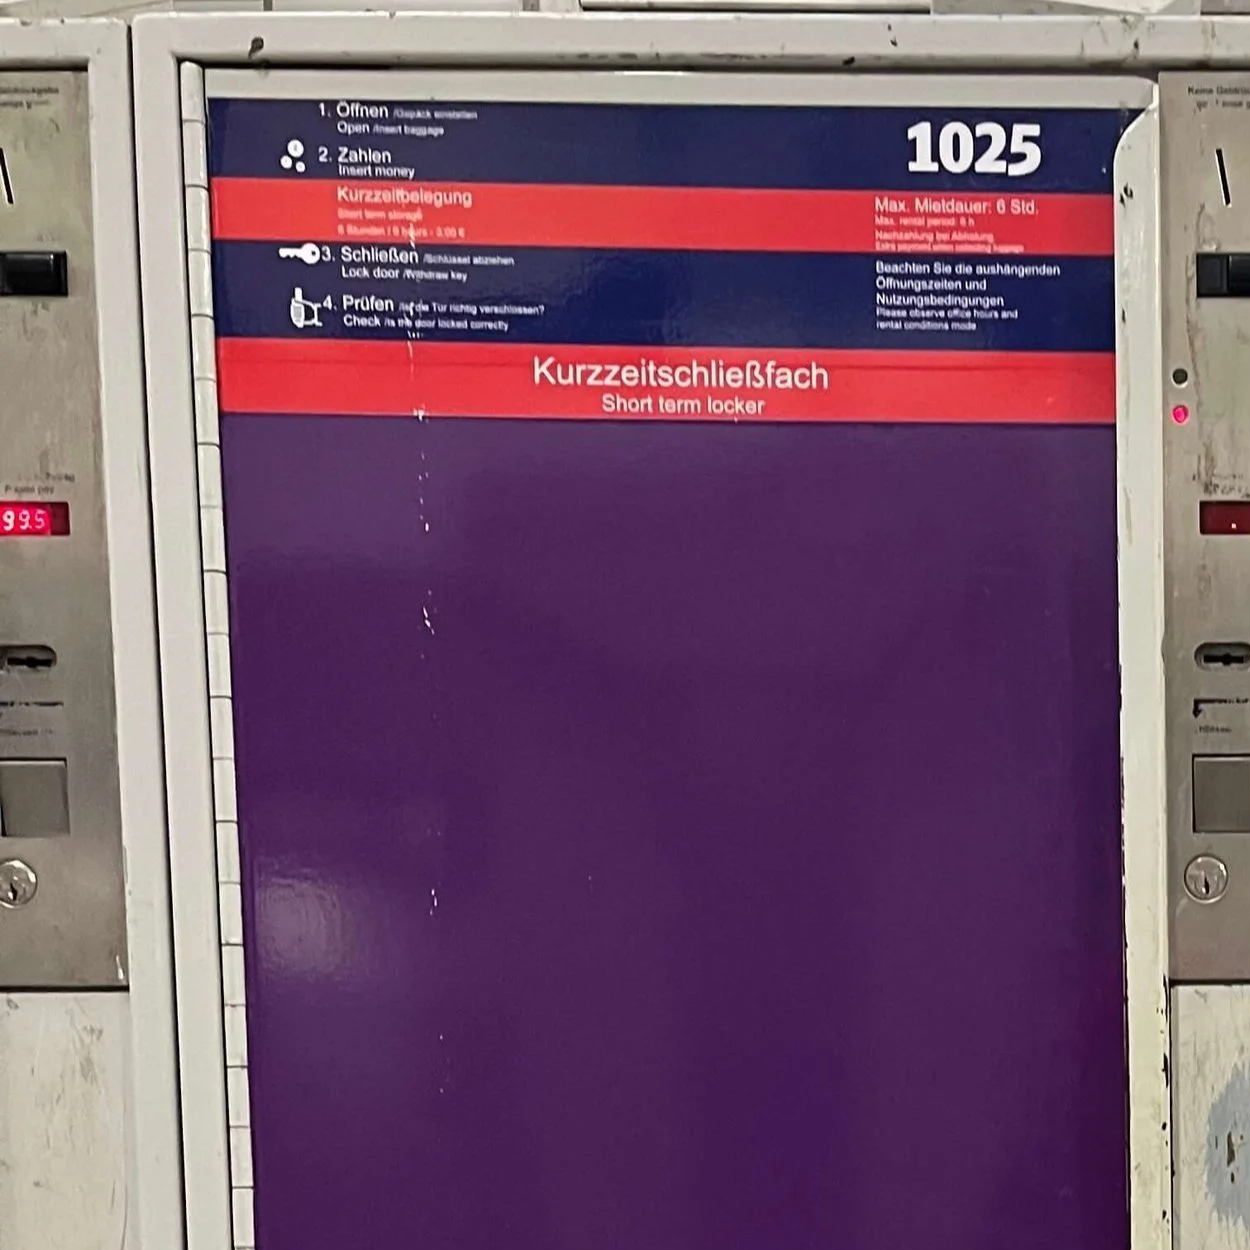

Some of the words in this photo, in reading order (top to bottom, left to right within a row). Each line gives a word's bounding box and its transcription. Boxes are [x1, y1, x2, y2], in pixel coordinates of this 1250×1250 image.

[318, 102, 331, 118] 1.
[336, 100, 389, 119] Öffnen
[337, 121, 370, 136] Open
[318, 147, 332, 163] 2.
[337, 147, 392, 164] Zahlen
[907, 121, 1042, 177] 1025
[339, 165, 373, 177] Insert
[375, 165, 415, 180] money
[337, 186, 473, 208] Kurzzeitbelegung
[874, 197, 910, 213] Max.
[915, 198, 992, 214] Mietdauer:
[996, 198, 1007, 214] 6
[1010, 198, 1039, 215] Std.
[321, 247, 335, 262] 3.
[341, 246, 419, 264] Schließen
[341, 267, 370, 278] Lock
[373, 266, 400, 279] door
[876, 261, 930, 275] Beachten
[933, 262, 952, 275] Sie
[955, 262, 973, 275] die
[975, 263, 1061, 278] aushängenden
[876, 276, 962, 292] Öffnungszeiten
[965, 278, 987, 291] und
[322, 296, 337, 311] 4.
[343, 294, 394, 312] Prüfen
[876, 292, 1004, 309] Nutzungsbedingungen
[343, 315, 380, 328] Check
[533, 355, 829, 390] Kurzzeitschließfach
[602, 393, 653, 413] Short
[658, 395, 700, 414] term
[707, 396, 765, 415] locker
